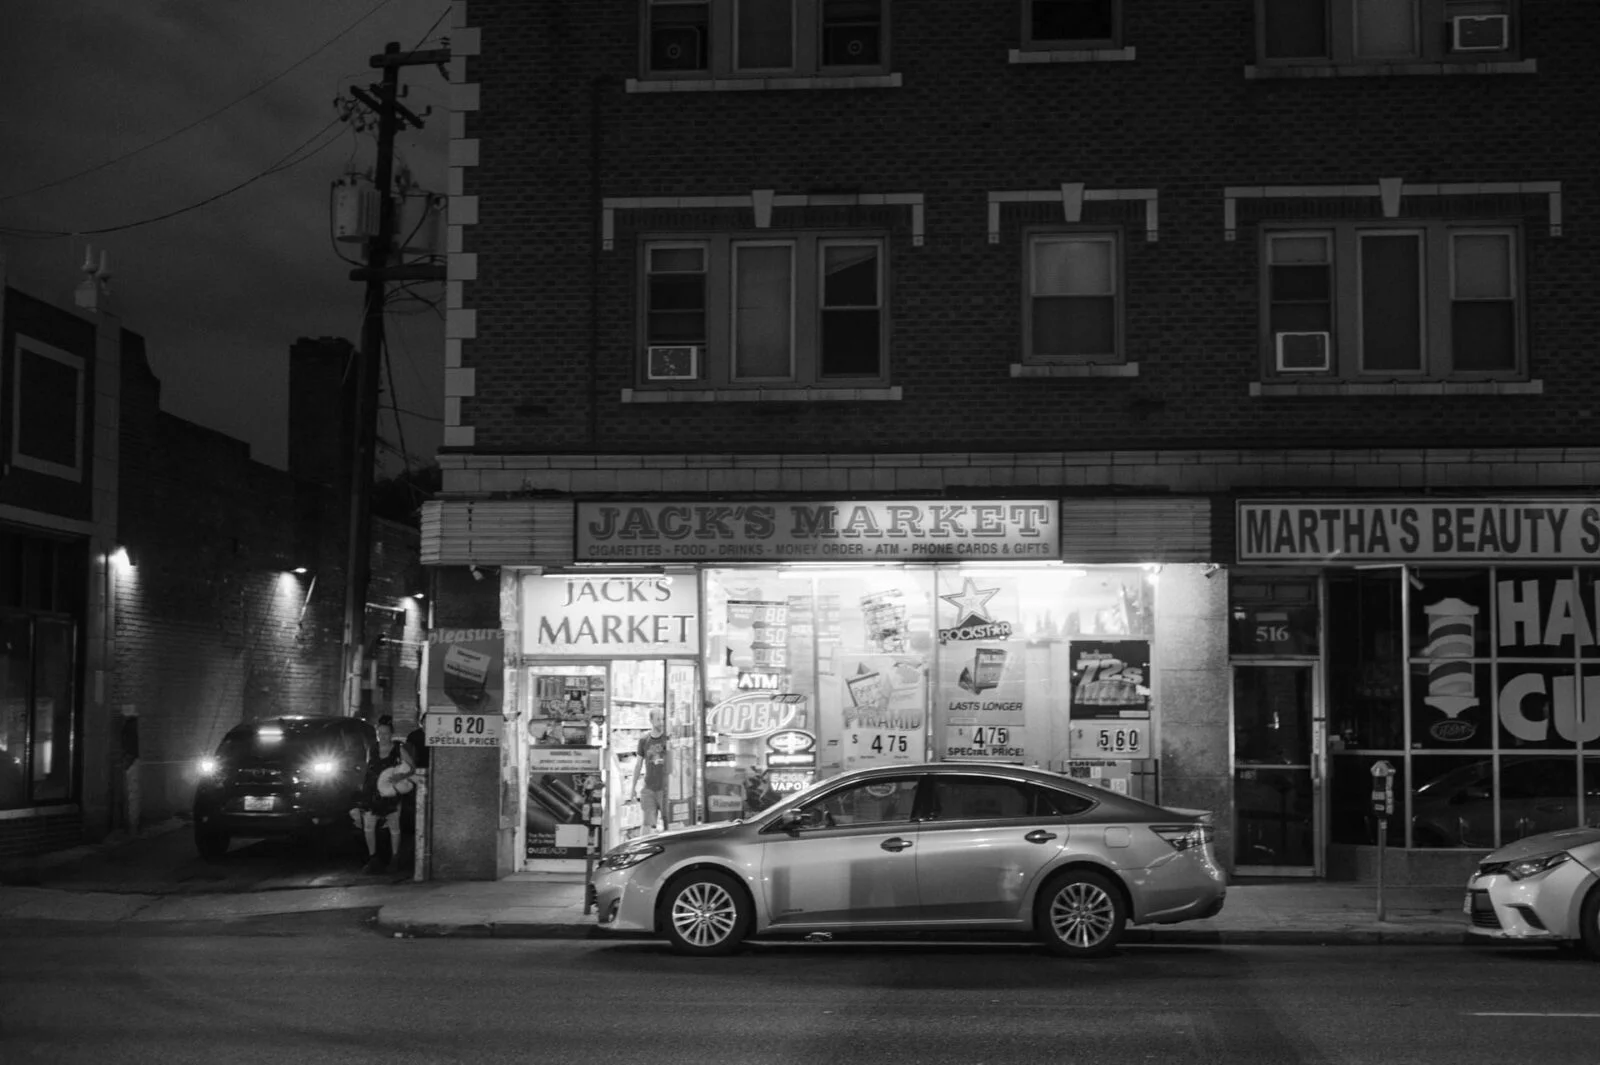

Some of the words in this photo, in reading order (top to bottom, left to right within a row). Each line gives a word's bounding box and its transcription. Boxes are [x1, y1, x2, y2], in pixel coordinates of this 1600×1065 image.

[588, 505, 776, 540] JACK'S
[790, 504, 1049, 539] MARKET
[1245, 507, 1420, 554] MARTHA'S
[1432, 507, 1569, 553] BEAUTY
[588, 544, 661, 556] CIGARETTES
[674, 544, 706, 556] FOOD
[719, 544, 763, 556] DRINKS
[776, 544, 818, 556] MONEY
[823, 543, 863, 555] ORDER
[875, 543, 899, 555] ATM
[912, 543, 952, 555] PHONE
[956, 543, 998, 554] CARDS
[1002, 543, 1010, 554] &
[1014, 543, 1049, 554] GIFTS
[561, 577, 671, 607] JACK'S
[1498, 579, 1600, 647] HA
[428, 628, 504, 645] pleasure
[538, 615, 694, 645] MARKET
[1255, 625, 1289, 643] 516
[739, 673, 778, 689] ATM
[949, 702, 980, 712] LASTS
[982, 702, 1023, 712] LONGER
[717, 702, 785, 731] OPEN
[428, 736, 467, 746] SPECIAL
[948, 747, 989, 757] SPECIAL
